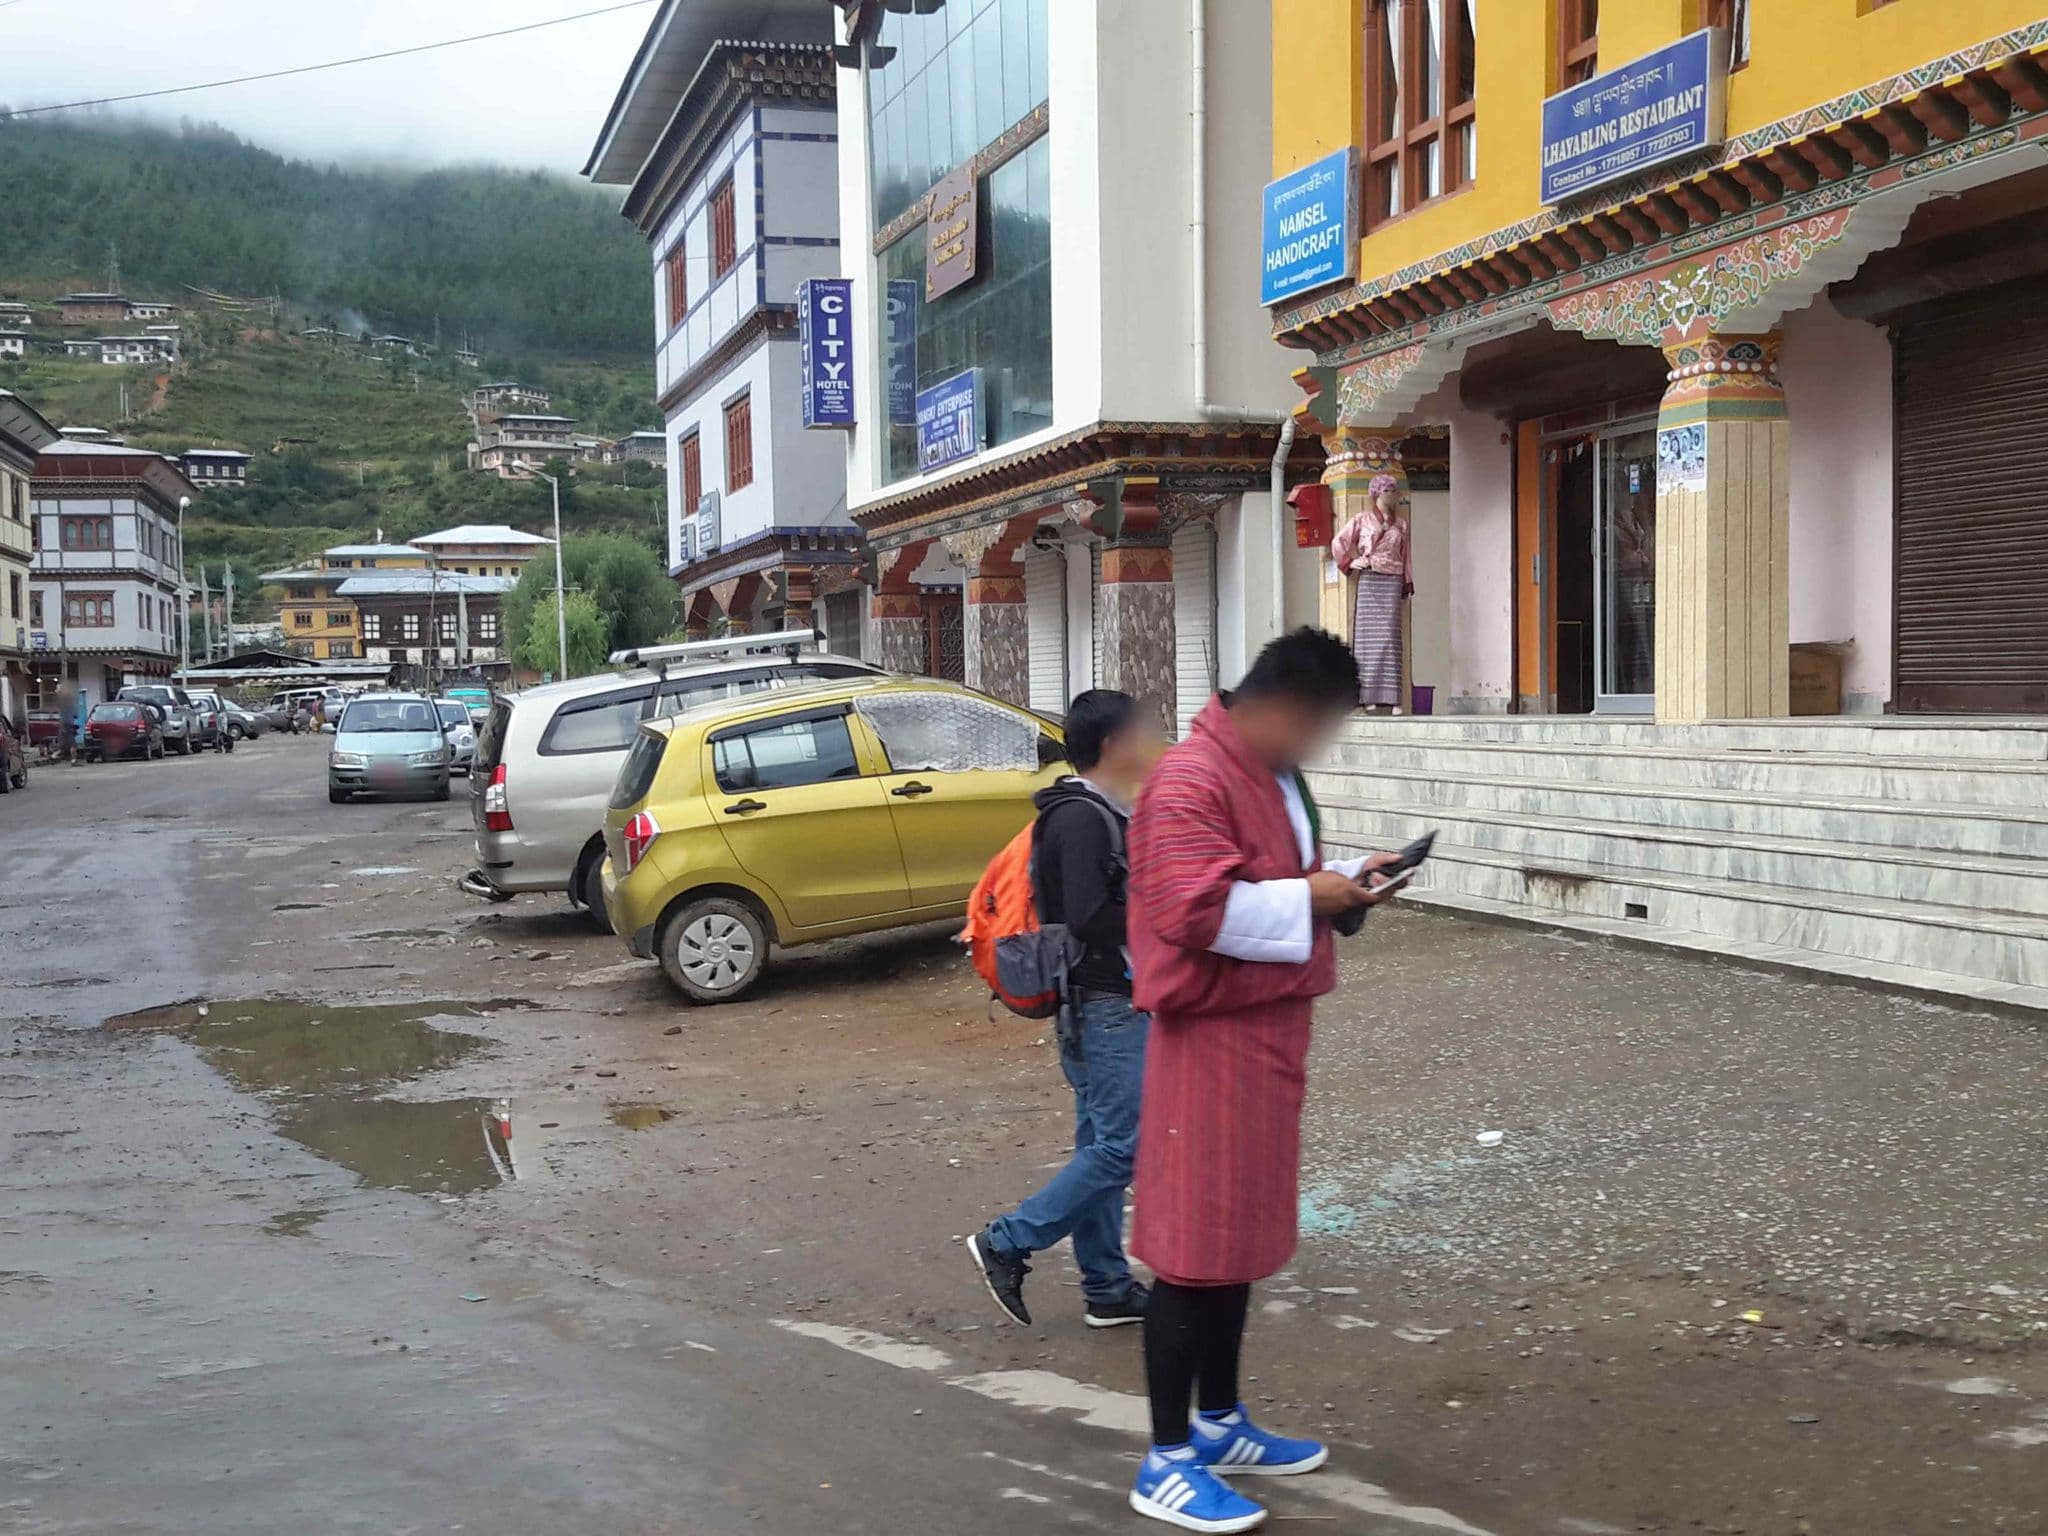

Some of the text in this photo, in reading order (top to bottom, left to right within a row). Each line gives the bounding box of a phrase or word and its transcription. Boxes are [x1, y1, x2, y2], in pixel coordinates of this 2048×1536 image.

[1543, 84, 1704, 168] LHAYABLING RESTAURANT
[1552, 168, 1585, 188] Contact
[1279, 201, 1328, 240] NAMSEL
[1266, 223, 1342, 273] HANDICRAFT
[820, 295, 846, 380] CITY
[816, 380, 851, 389] HOTEL
[937, 388, 973, 417] ENTERPRISE
